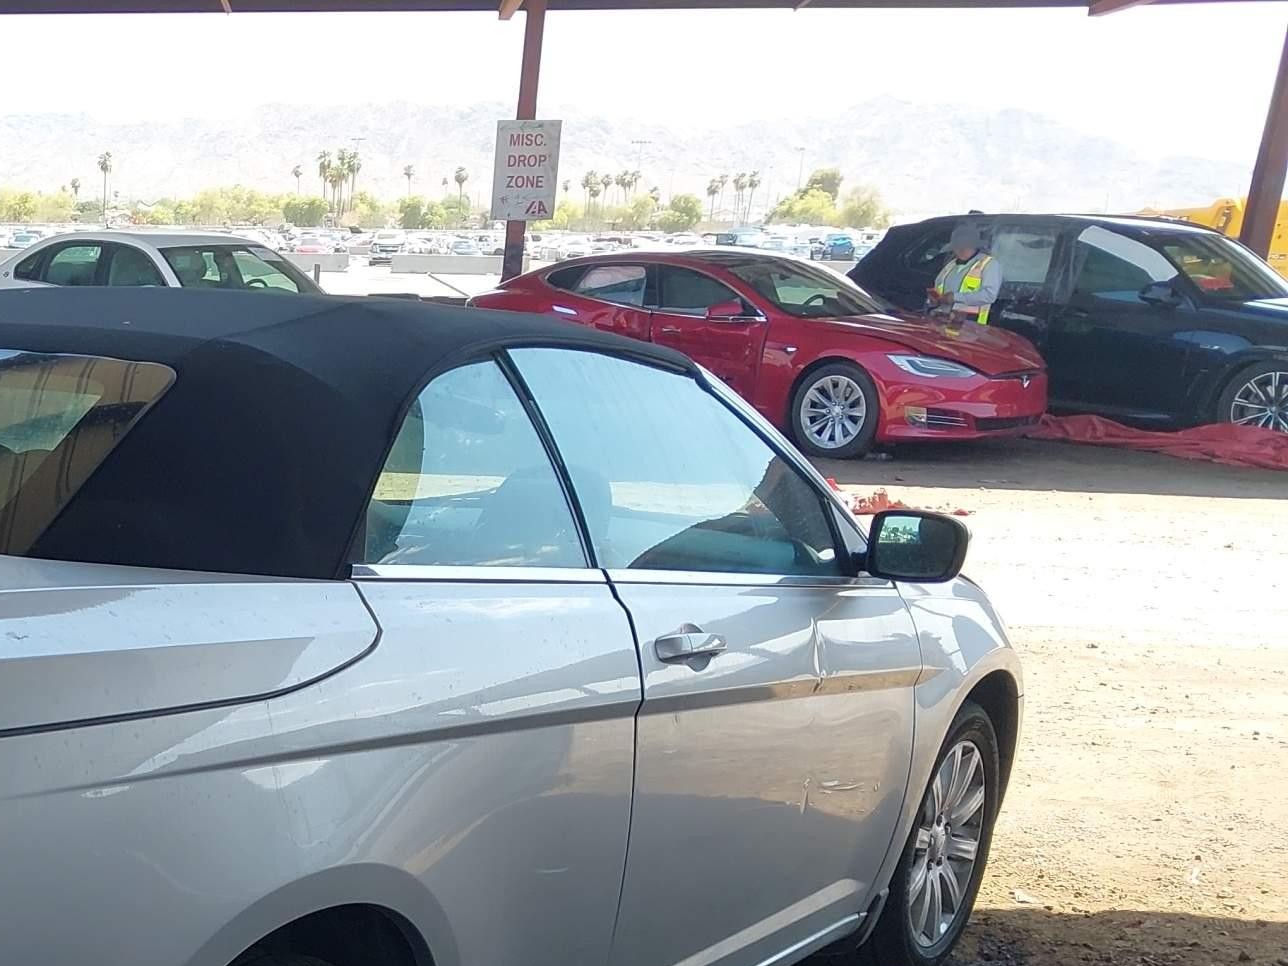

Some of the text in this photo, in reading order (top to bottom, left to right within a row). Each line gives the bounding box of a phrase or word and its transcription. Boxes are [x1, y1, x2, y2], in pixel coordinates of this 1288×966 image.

[509, 133, 547, 147] MISC.
[507, 154, 547, 168] DROP
[505, 175, 544, 189] ZONE
